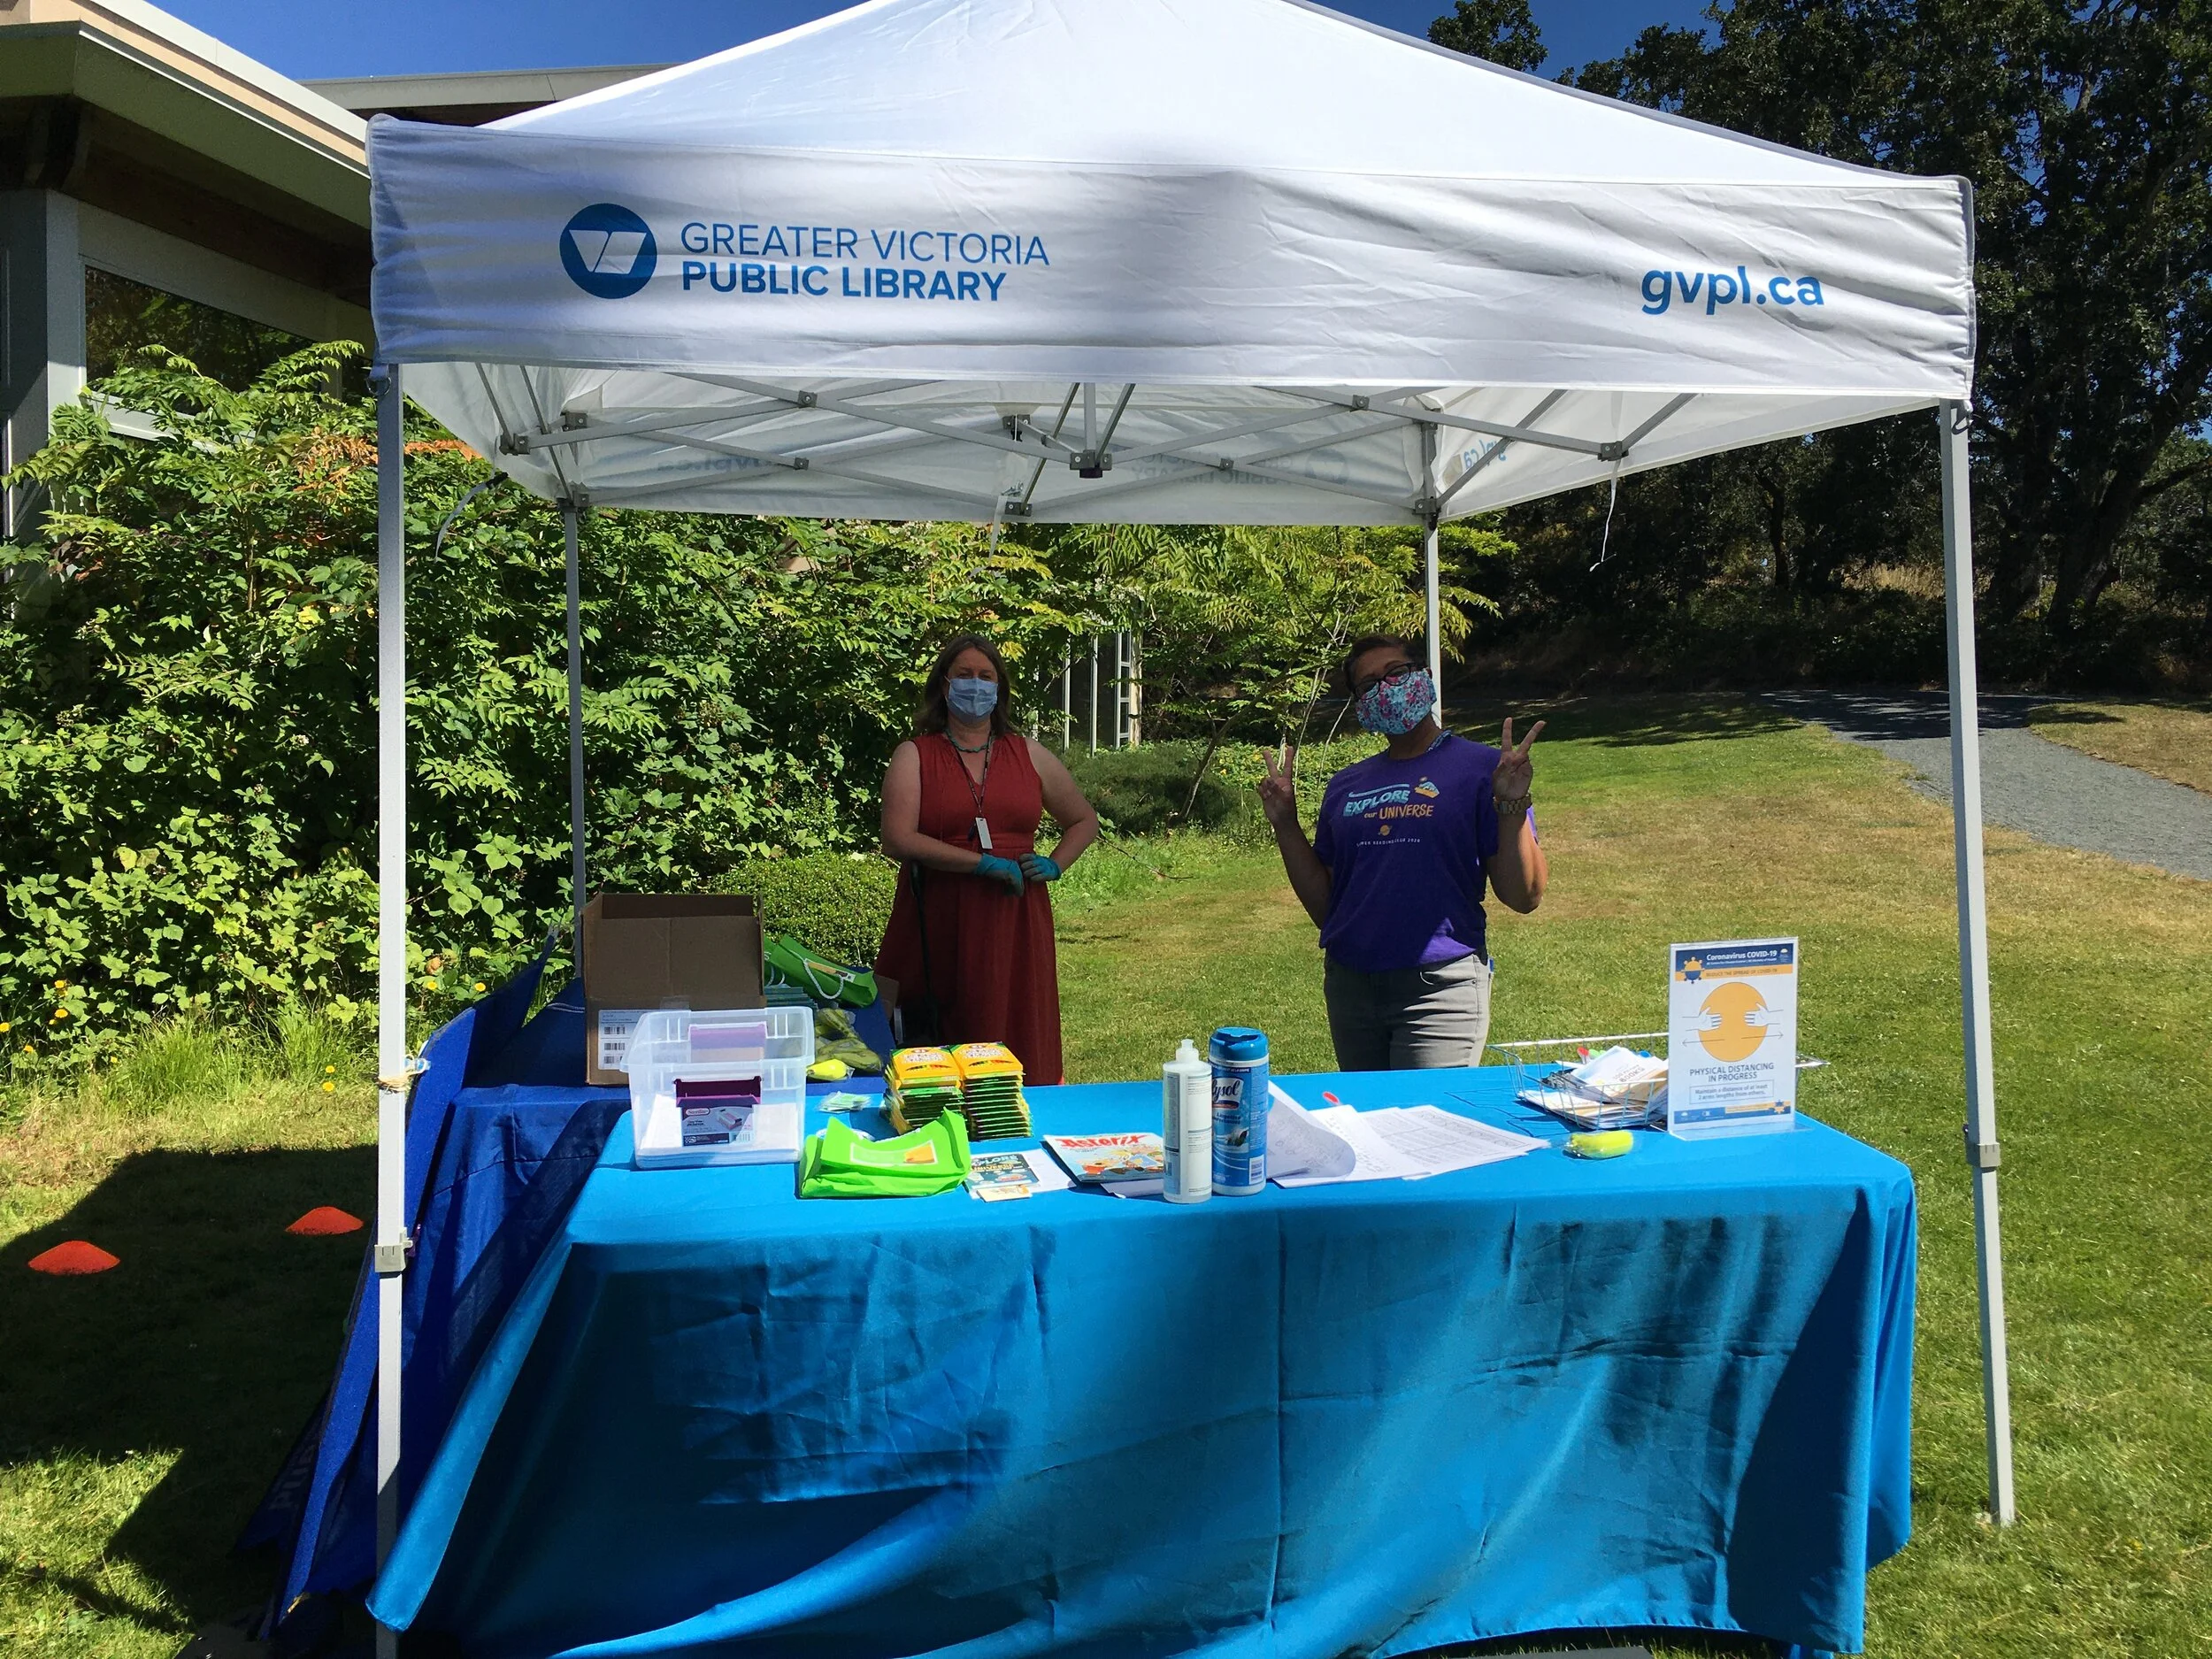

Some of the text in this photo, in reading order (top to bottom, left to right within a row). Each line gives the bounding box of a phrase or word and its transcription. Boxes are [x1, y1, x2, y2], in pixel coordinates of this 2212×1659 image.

[680, 222, 1050, 265] GREATER VICTORIA
[682, 261, 1007, 302] PUBLIC LIBRARY
[1641, 265, 1824, 315] gvpl.ca
[1343, 790, 1410, 817] EXPLORE
[1379, 803, 1435, 820] UNIVERSE
[1706, 952, 1747, 962] Coronavirus
[1747, 949, 1778, 958] COVID-19
[1690, 1063, 1775, 1076] PHYSICAL DISTANCING
[1718, 1071, 1757, 1081] PROGRESS
[1055, 1134, 1149, 1148] Asterix
